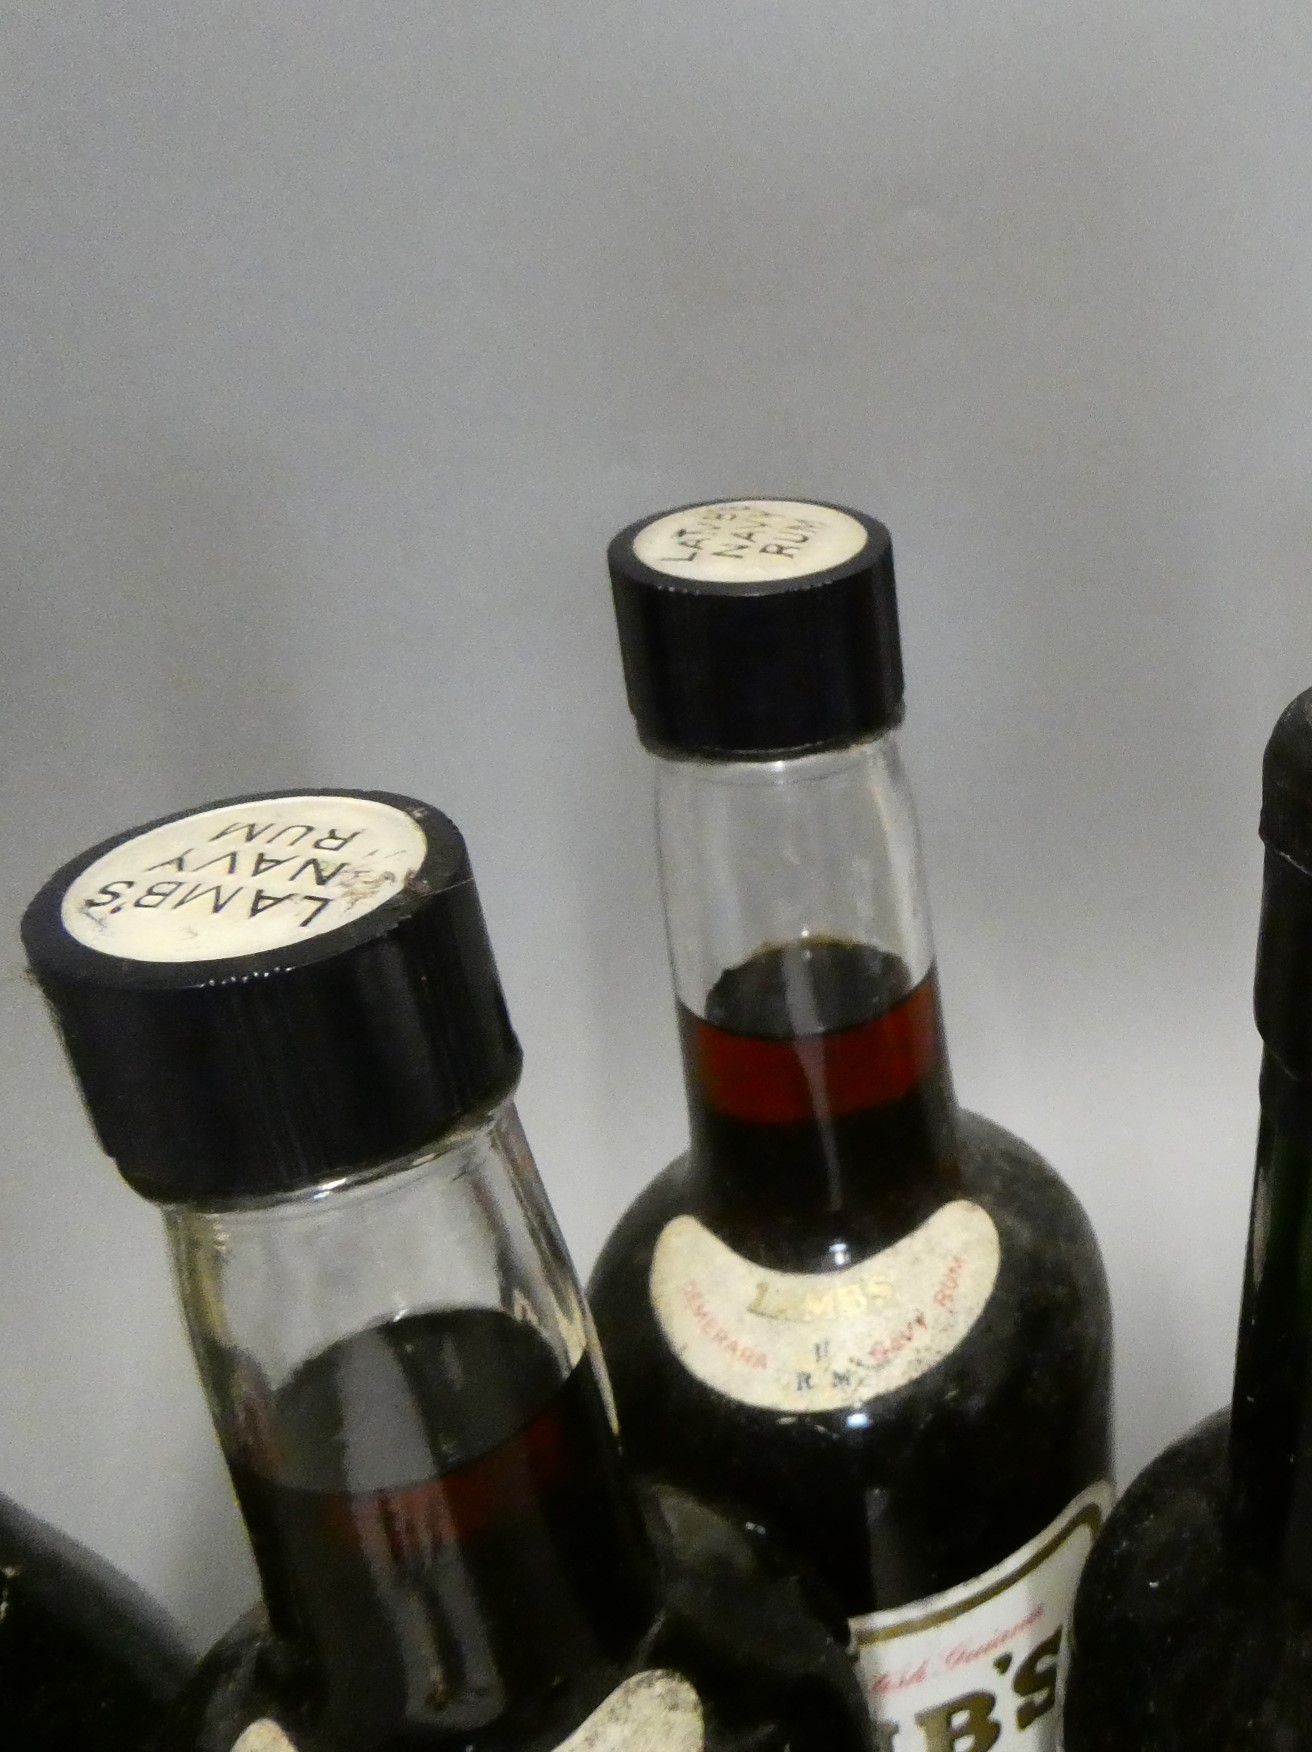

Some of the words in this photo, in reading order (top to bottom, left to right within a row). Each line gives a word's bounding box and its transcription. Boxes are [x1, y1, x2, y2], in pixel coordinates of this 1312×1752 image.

[759, 518, 827, 559] RUM
[209, 822, 364, 853] RUM
[147, 847, 349, 887] NAVY
[86, 879, 332, 928] LAMB'S
[872, 1624, 1064, 1752] B'S
